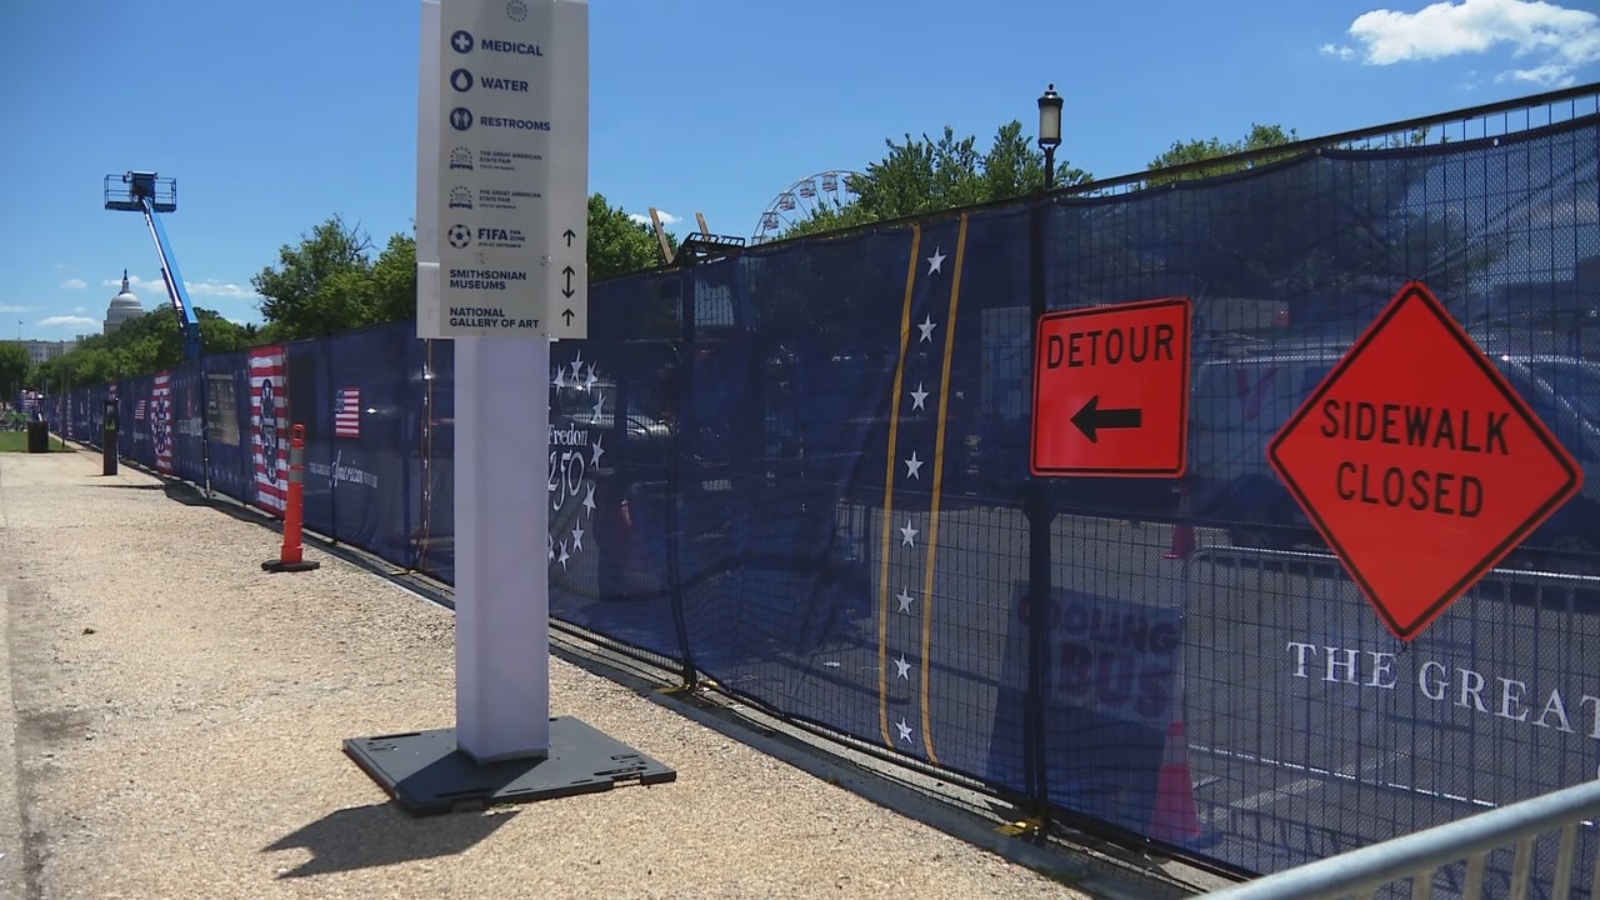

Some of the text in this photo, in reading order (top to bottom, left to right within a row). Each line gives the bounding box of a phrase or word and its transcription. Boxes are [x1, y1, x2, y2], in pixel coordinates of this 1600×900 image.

[481, 39, 543, 57] MEDICAL
[480, 77, 529, 92] WATER
[480, 116, 551, 131] RESTROOMS
[511, 191, 541, 199] AMERICAN
[478, 228, 508, 241] FIFA
[450, 269, 526, 280] SMITHSONIAN
[450, 279, 506, 290] MUSEUMS
[450, 307, 505, 317] NATIONAL
[450, 318, 539, 329] GALLERY OF ART
[1046, 323, 1176, 369] DETOUR
[1320, 398, 1510, 456] SIDEWALK
[1337, 462, 1483, 518] CLOSED
[1286, 640, 1398, 690] THE
[1058, 639, 1172, 718] BUS
